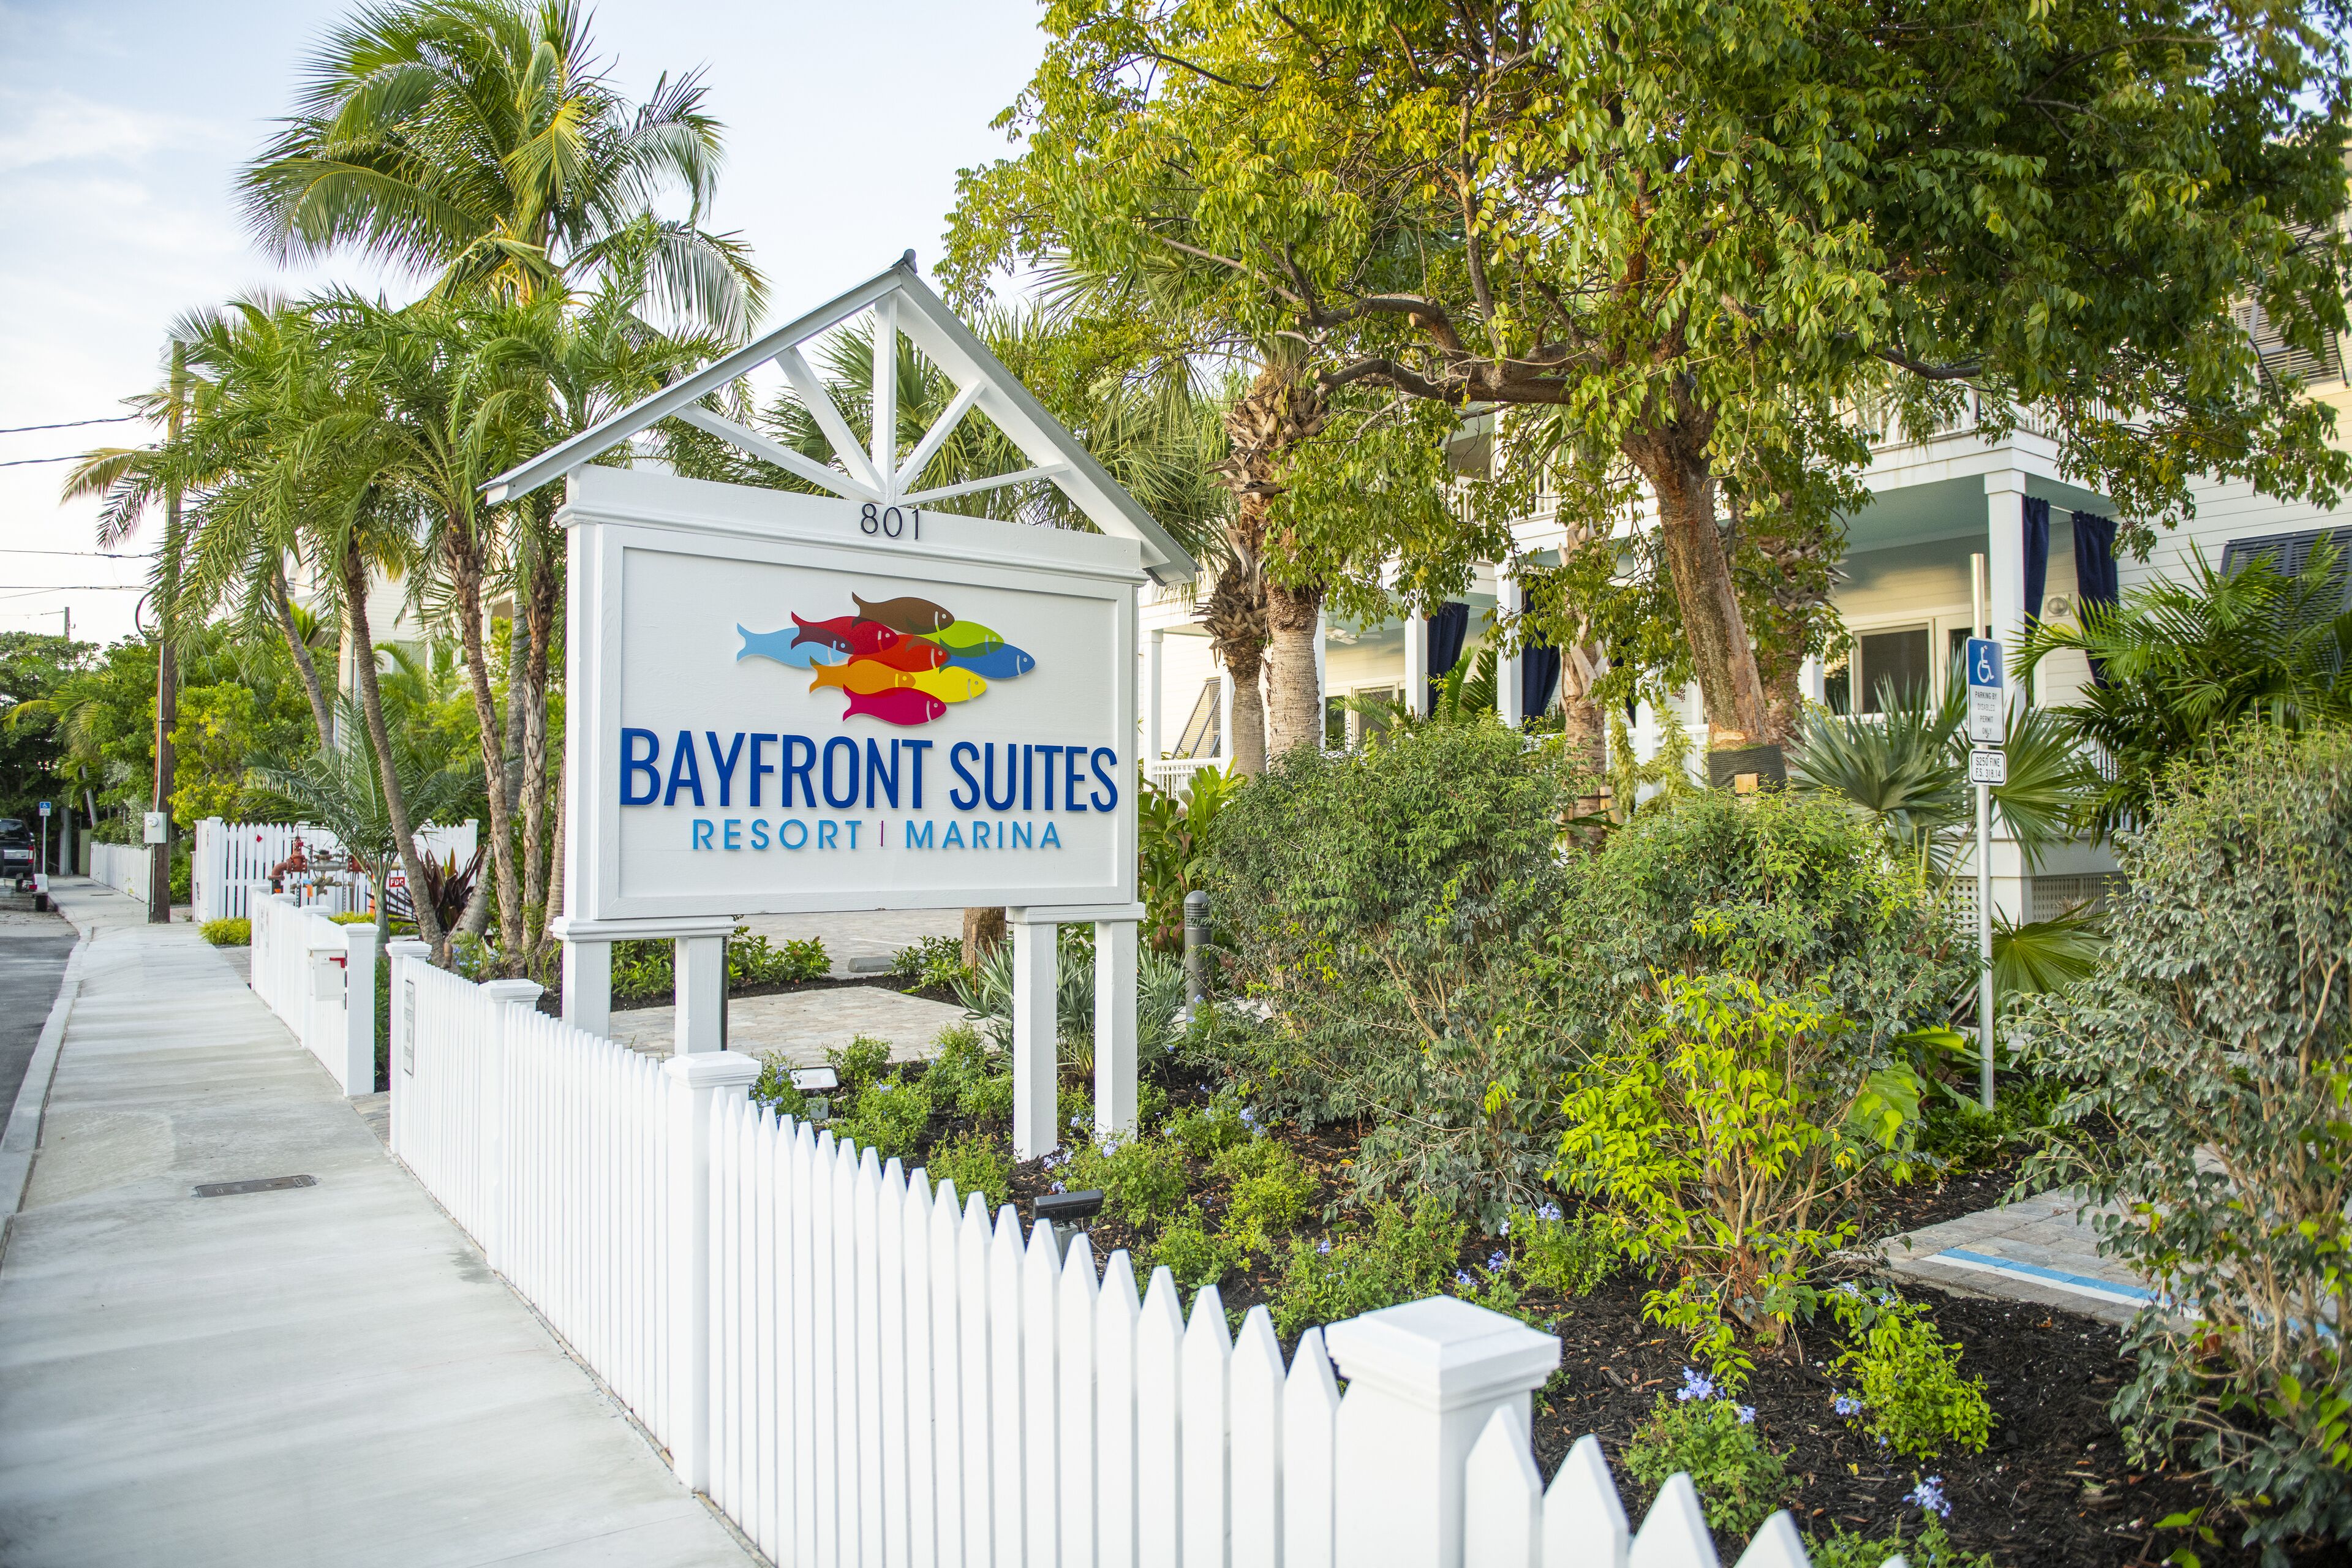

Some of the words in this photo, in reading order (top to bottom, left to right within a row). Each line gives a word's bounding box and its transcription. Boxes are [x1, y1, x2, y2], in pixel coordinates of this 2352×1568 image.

[860, 503, 920, 540] 801
[1975, 691, 1991, 699] PARKING
[1977, 703, 1995, 712] DISABLED
[1989, 757, 2000, 767] FINE
[620, 727, 933, 810] BAYFRONT
[949, 741, 1118, 813] SUITES
[1975, 767, 1984, 777] F.S.
[1985, 769, 2001, 778] 318.14
[692, 818, 862, 851] RESORT
[905, 820, 1062, 850] MARINA
